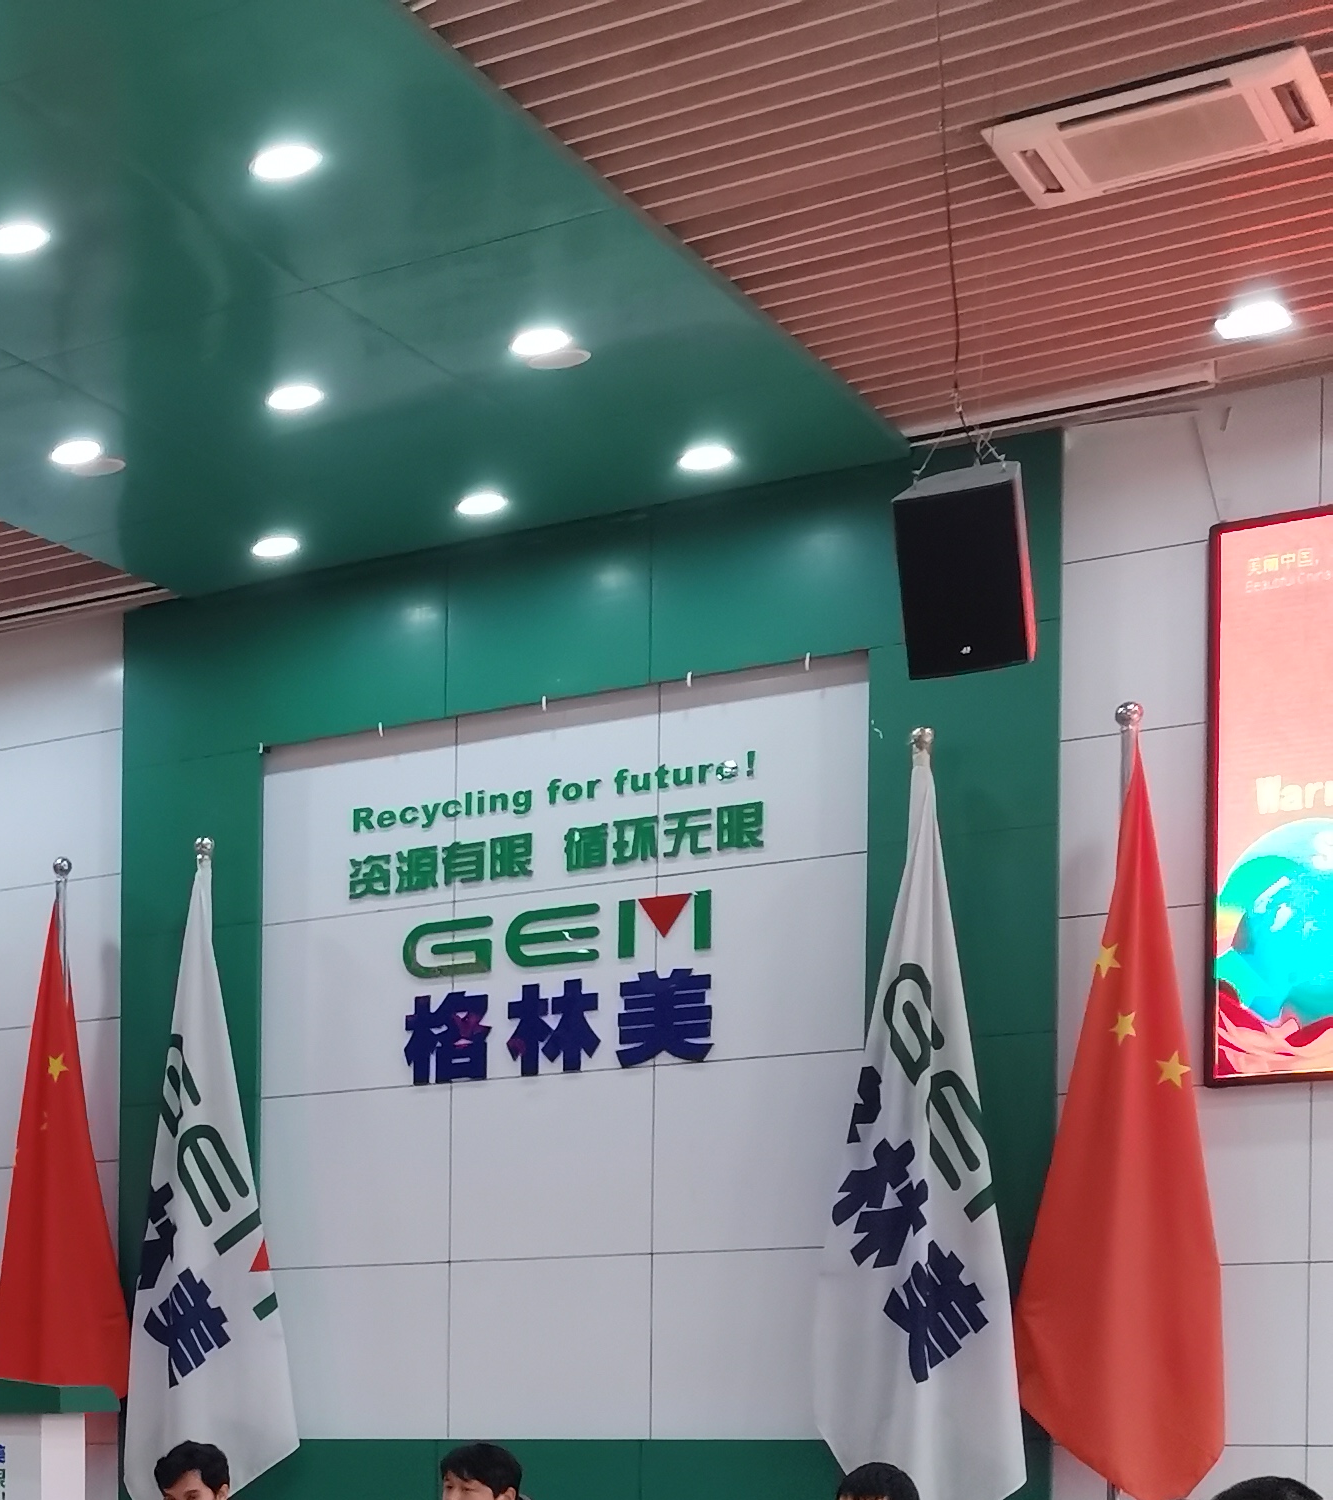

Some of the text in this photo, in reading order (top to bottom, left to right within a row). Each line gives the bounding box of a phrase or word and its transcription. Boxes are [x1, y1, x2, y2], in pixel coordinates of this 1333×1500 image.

[351, 750, 757, 833] Recycling for future!
[348, 800, 765, 900] 资源有限 循环无限
[402, 887, 713, 979] GEM
[404, 968, 715, 1086] 格林美
